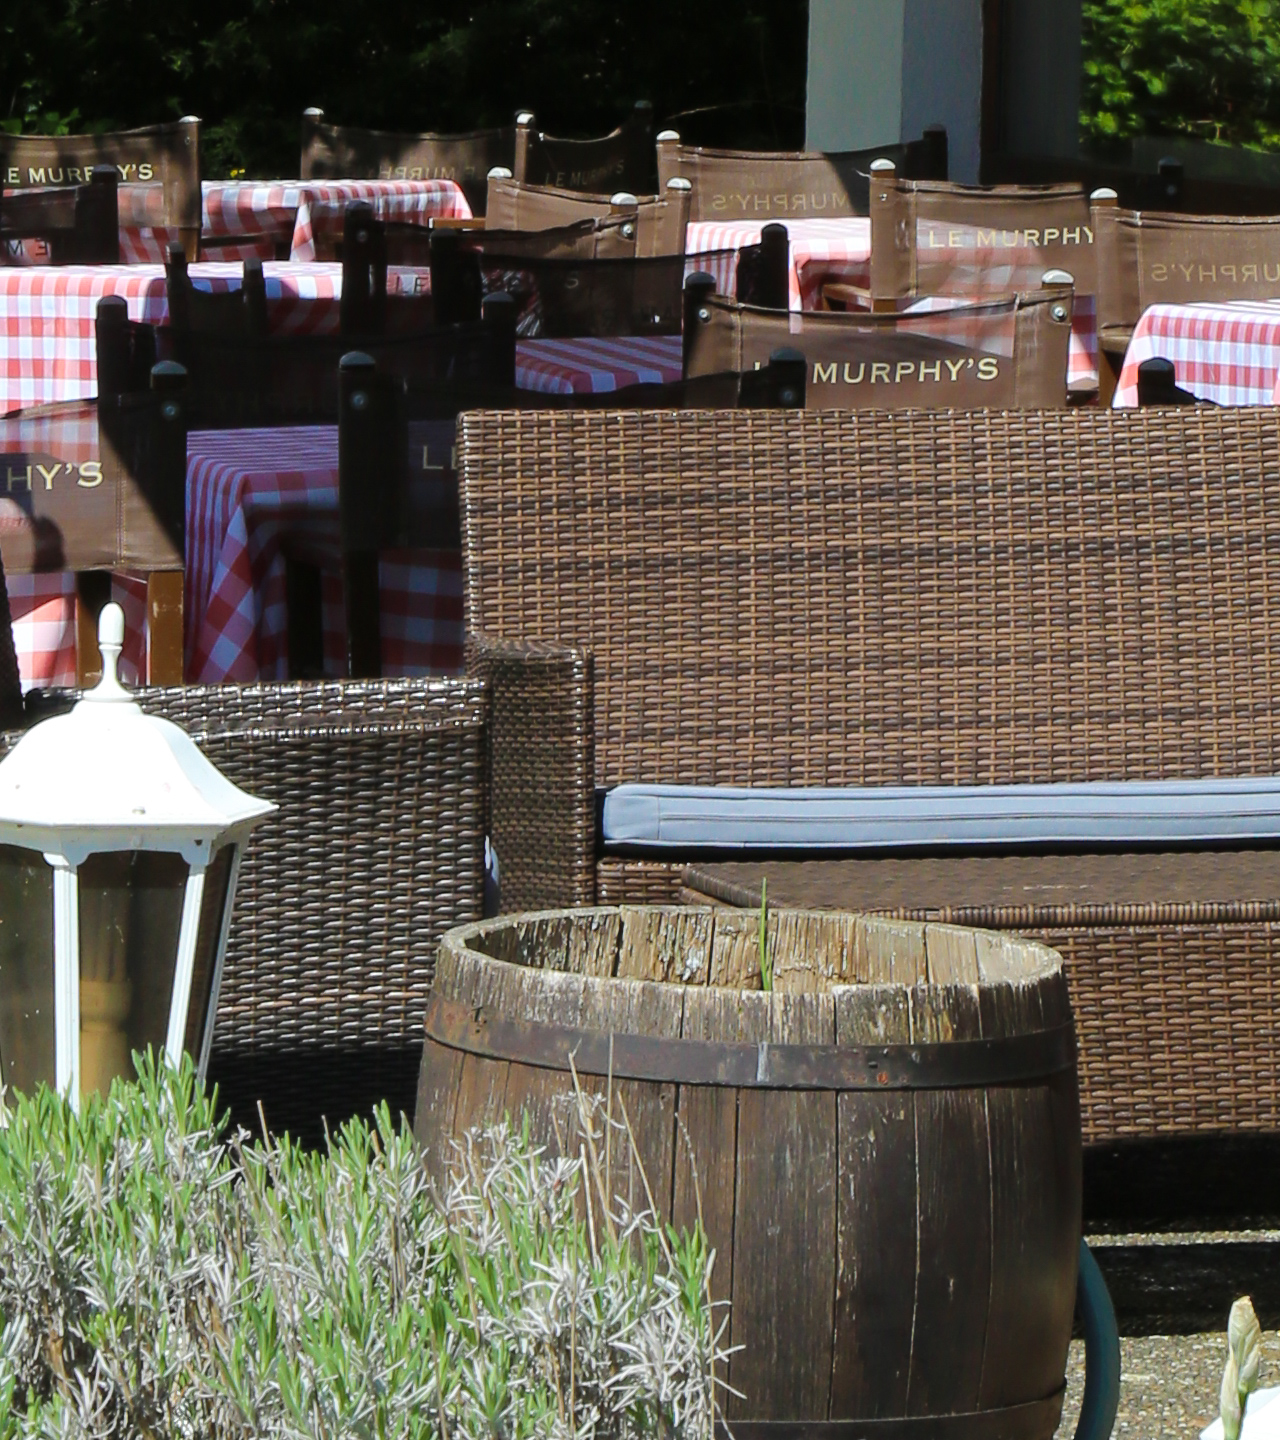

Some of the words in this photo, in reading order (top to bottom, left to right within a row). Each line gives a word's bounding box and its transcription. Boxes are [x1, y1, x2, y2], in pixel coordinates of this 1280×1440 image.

[3, 167, 20, 183] E
[929, 229, 963, 248] LE
[812, 358, 999, 384] MURPHY'S
